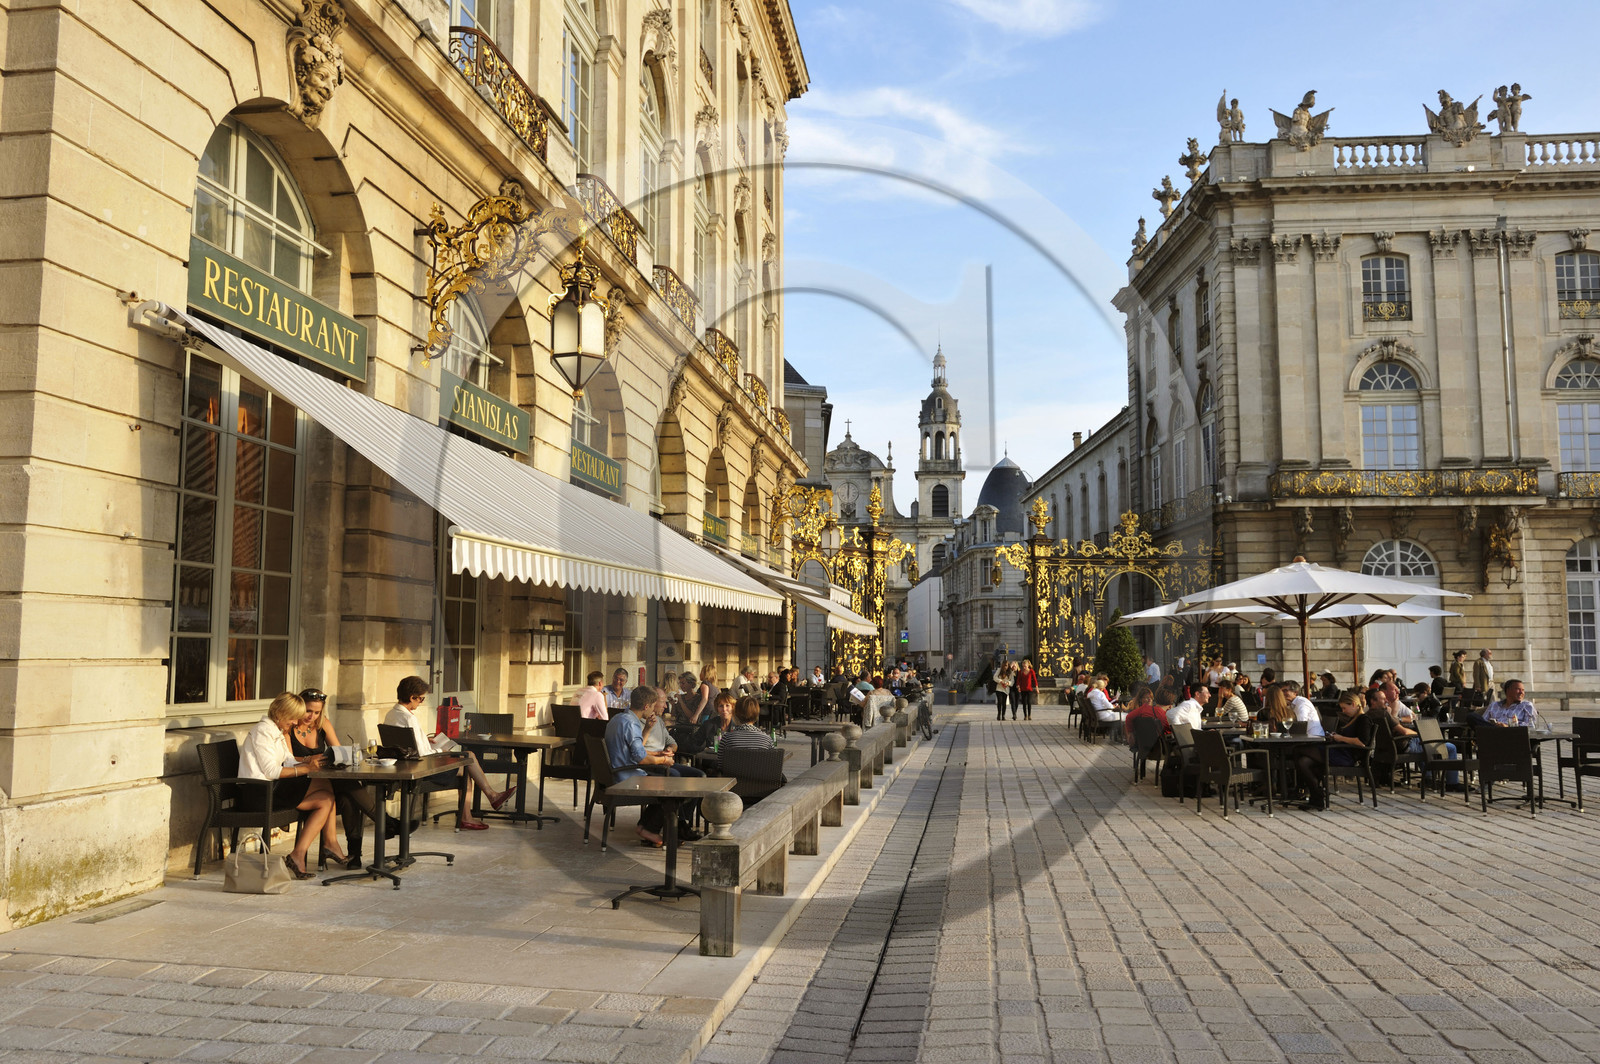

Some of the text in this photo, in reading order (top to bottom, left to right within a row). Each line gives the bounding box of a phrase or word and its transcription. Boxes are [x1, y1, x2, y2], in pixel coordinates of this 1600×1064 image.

[203, 256, 359, 365] RESTAURANT
[452, 385, 519, 441] STANISLAS
[571, 445, 620, 489] RESTAURANT
